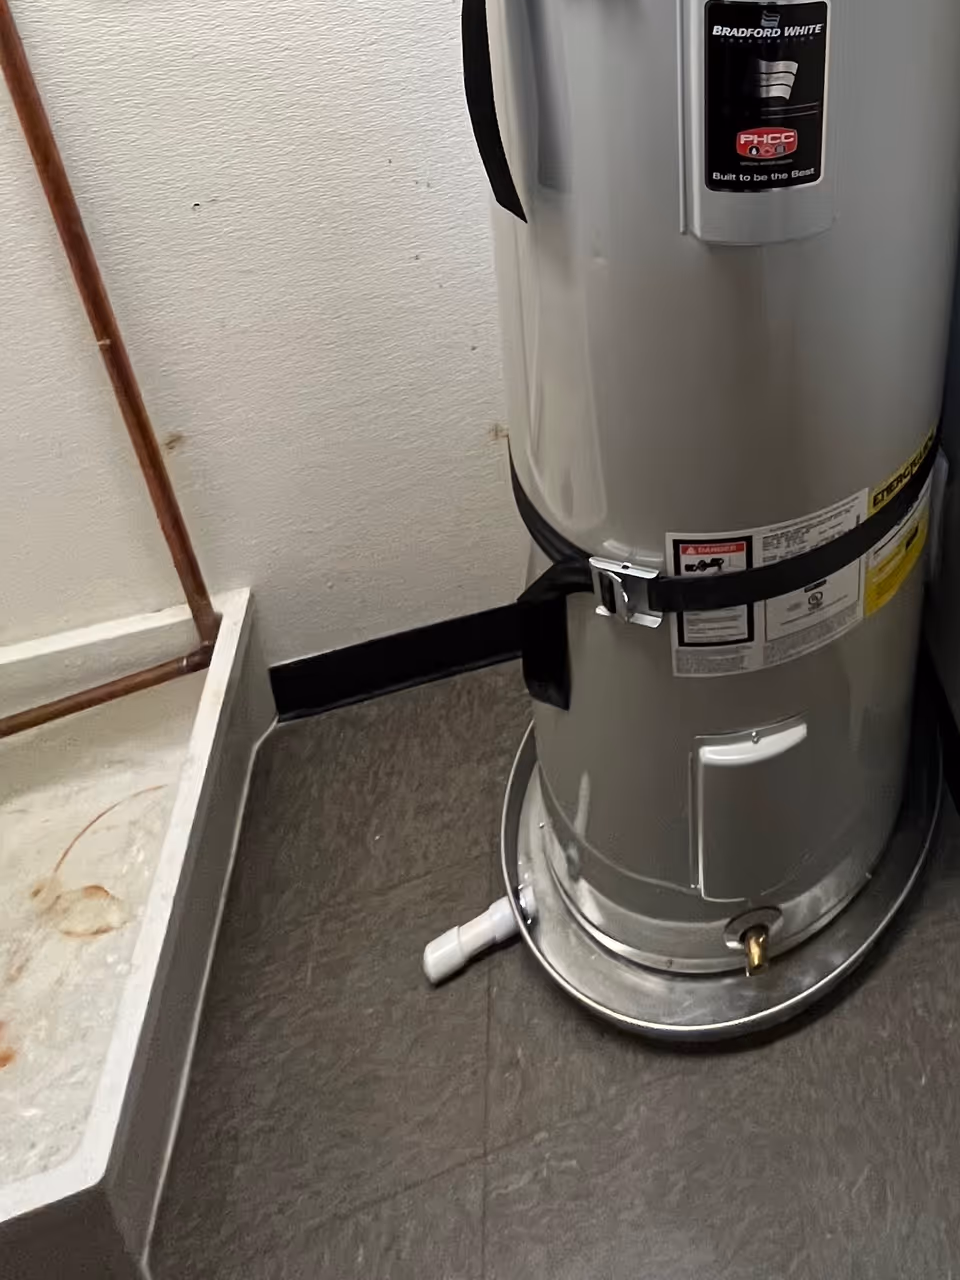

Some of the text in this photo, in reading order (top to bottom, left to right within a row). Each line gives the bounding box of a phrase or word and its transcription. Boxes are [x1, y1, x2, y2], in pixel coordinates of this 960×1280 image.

[712, 23, 823, 39] BRADFORD WHITE
[739, 131, 796, 145] PHCC
[712, 167, 816, 183] Built to be the Best
